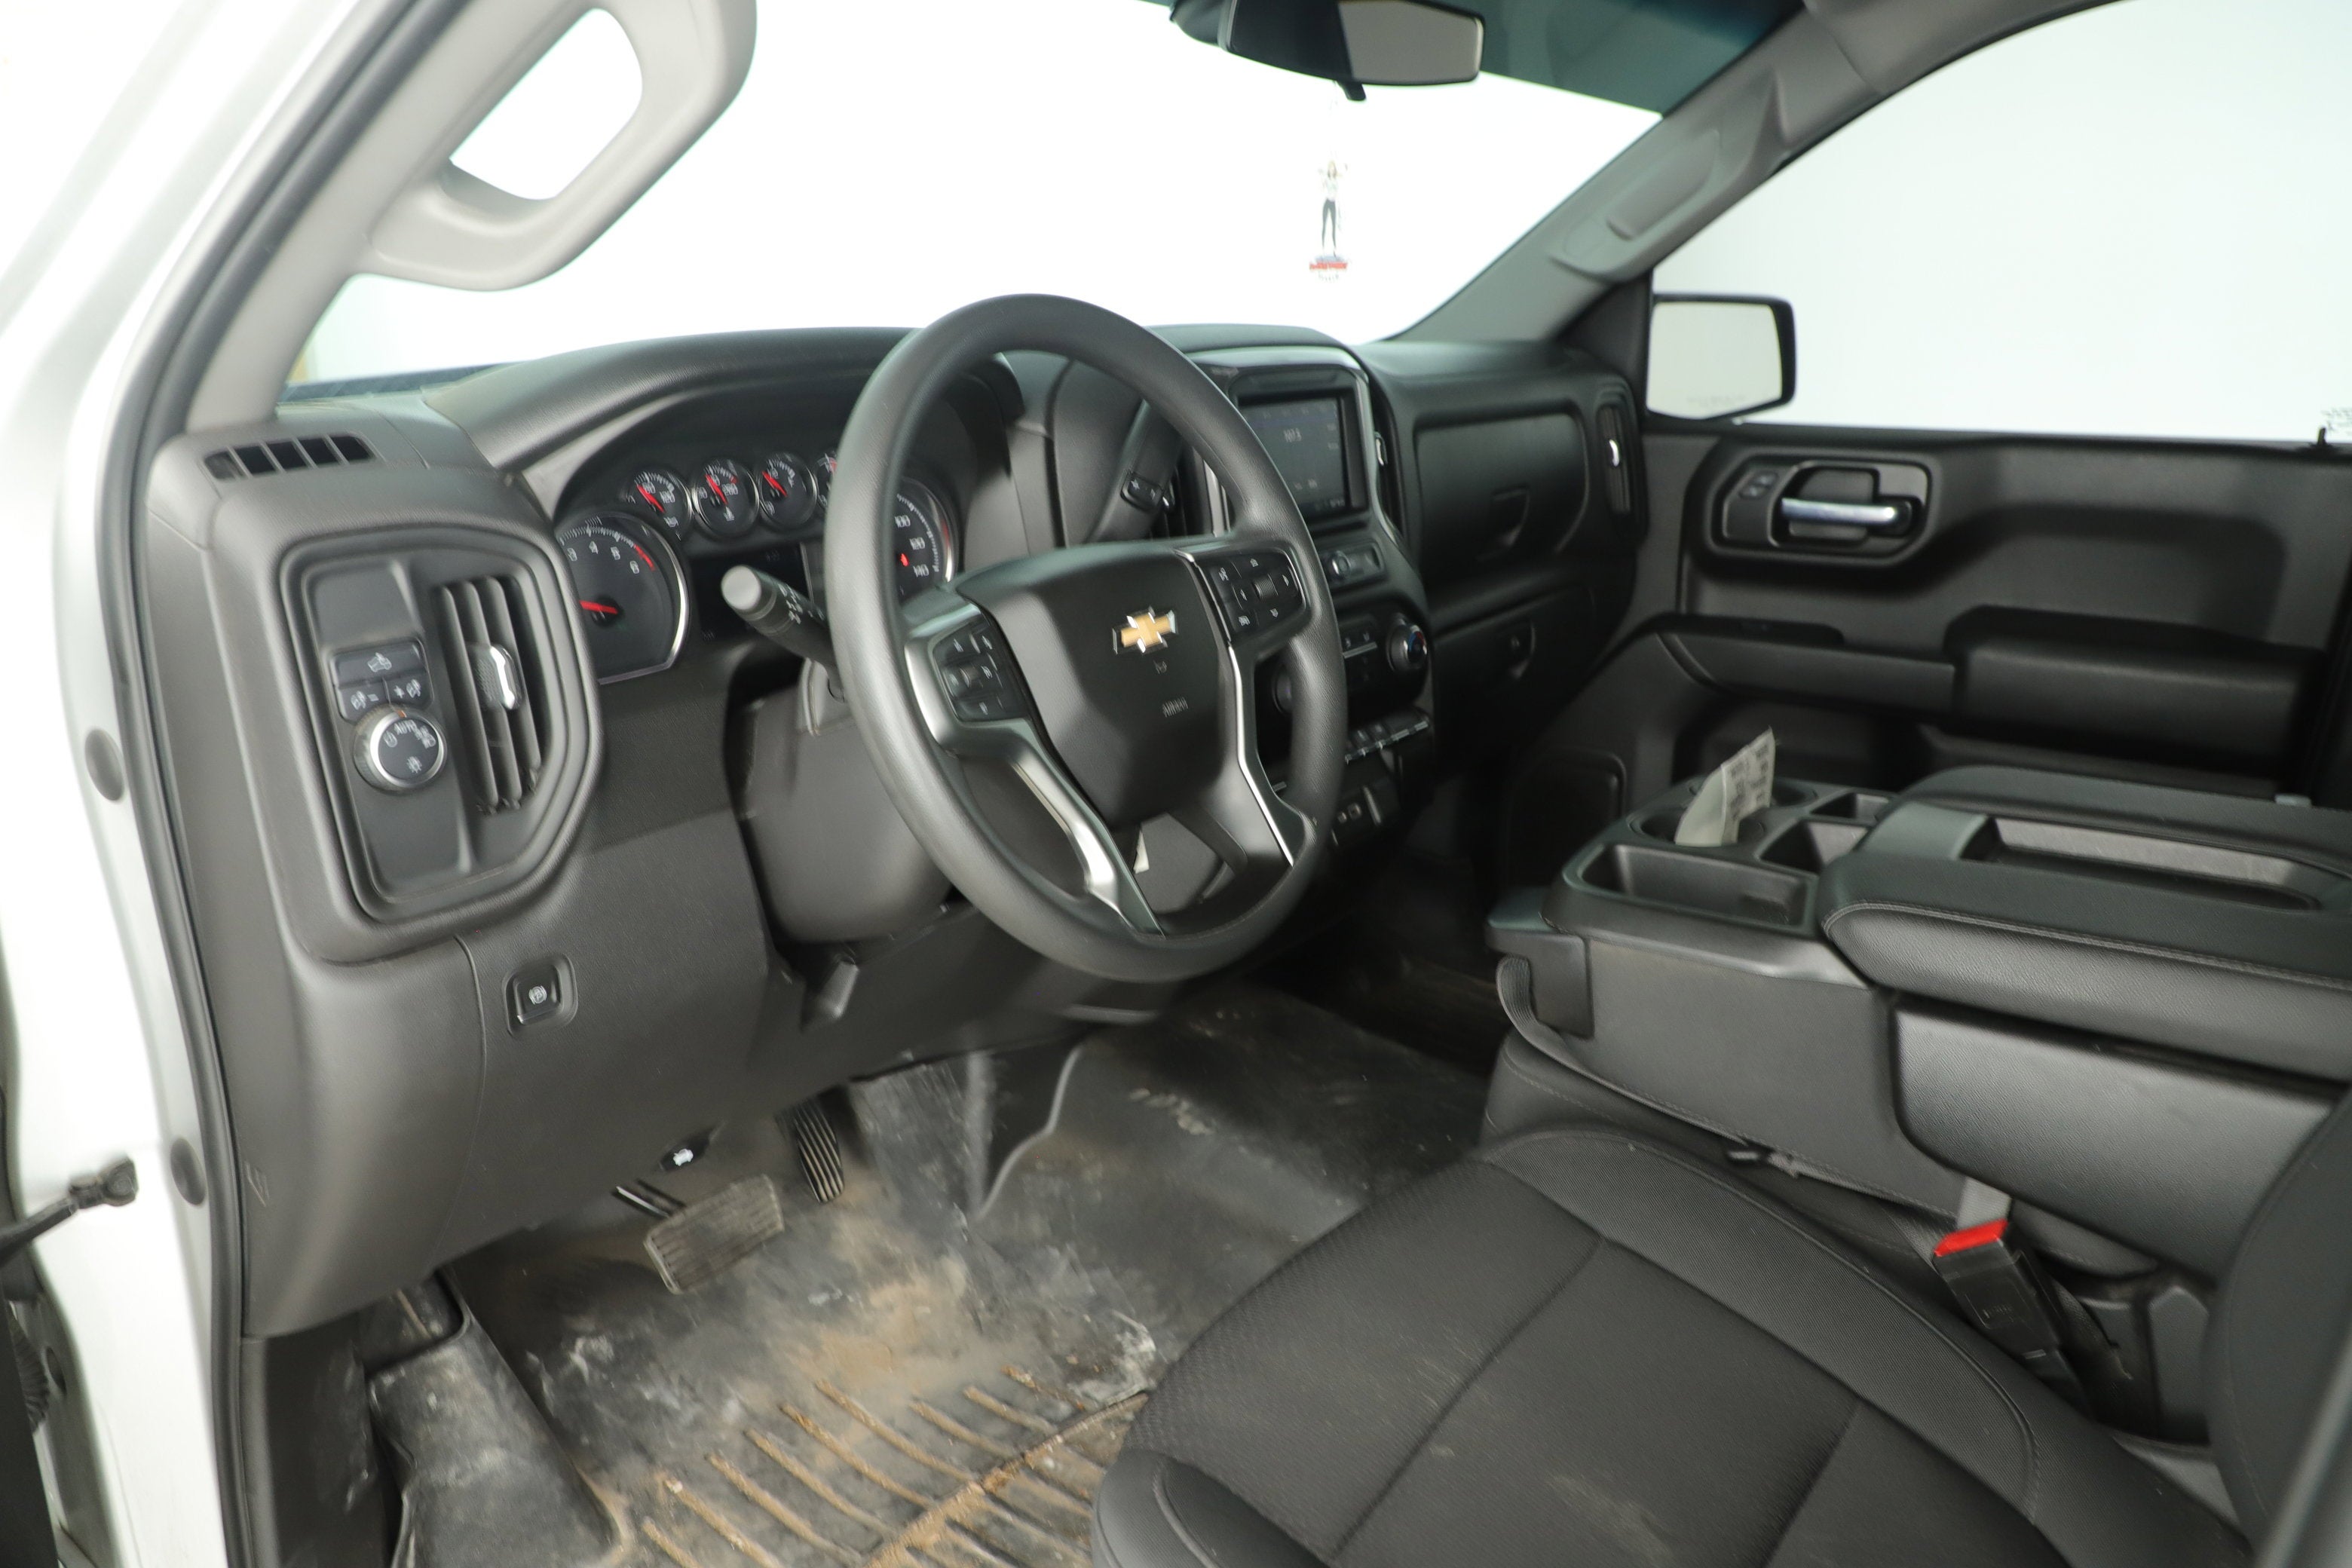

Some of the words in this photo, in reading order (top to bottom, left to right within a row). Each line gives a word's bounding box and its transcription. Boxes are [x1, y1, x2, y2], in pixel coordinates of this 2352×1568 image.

[894, 514, 911, 528] 100
[589, 541, 599, 554] 4
[909, 536, 926, 550] 120
[567, 547, 578, 562] 3
[610, 546, 621, 560] 5
[629, 560, 640, 574] 6
[913, 563, 929, 577] 140
[394, 719, 418, 736] AUTO
